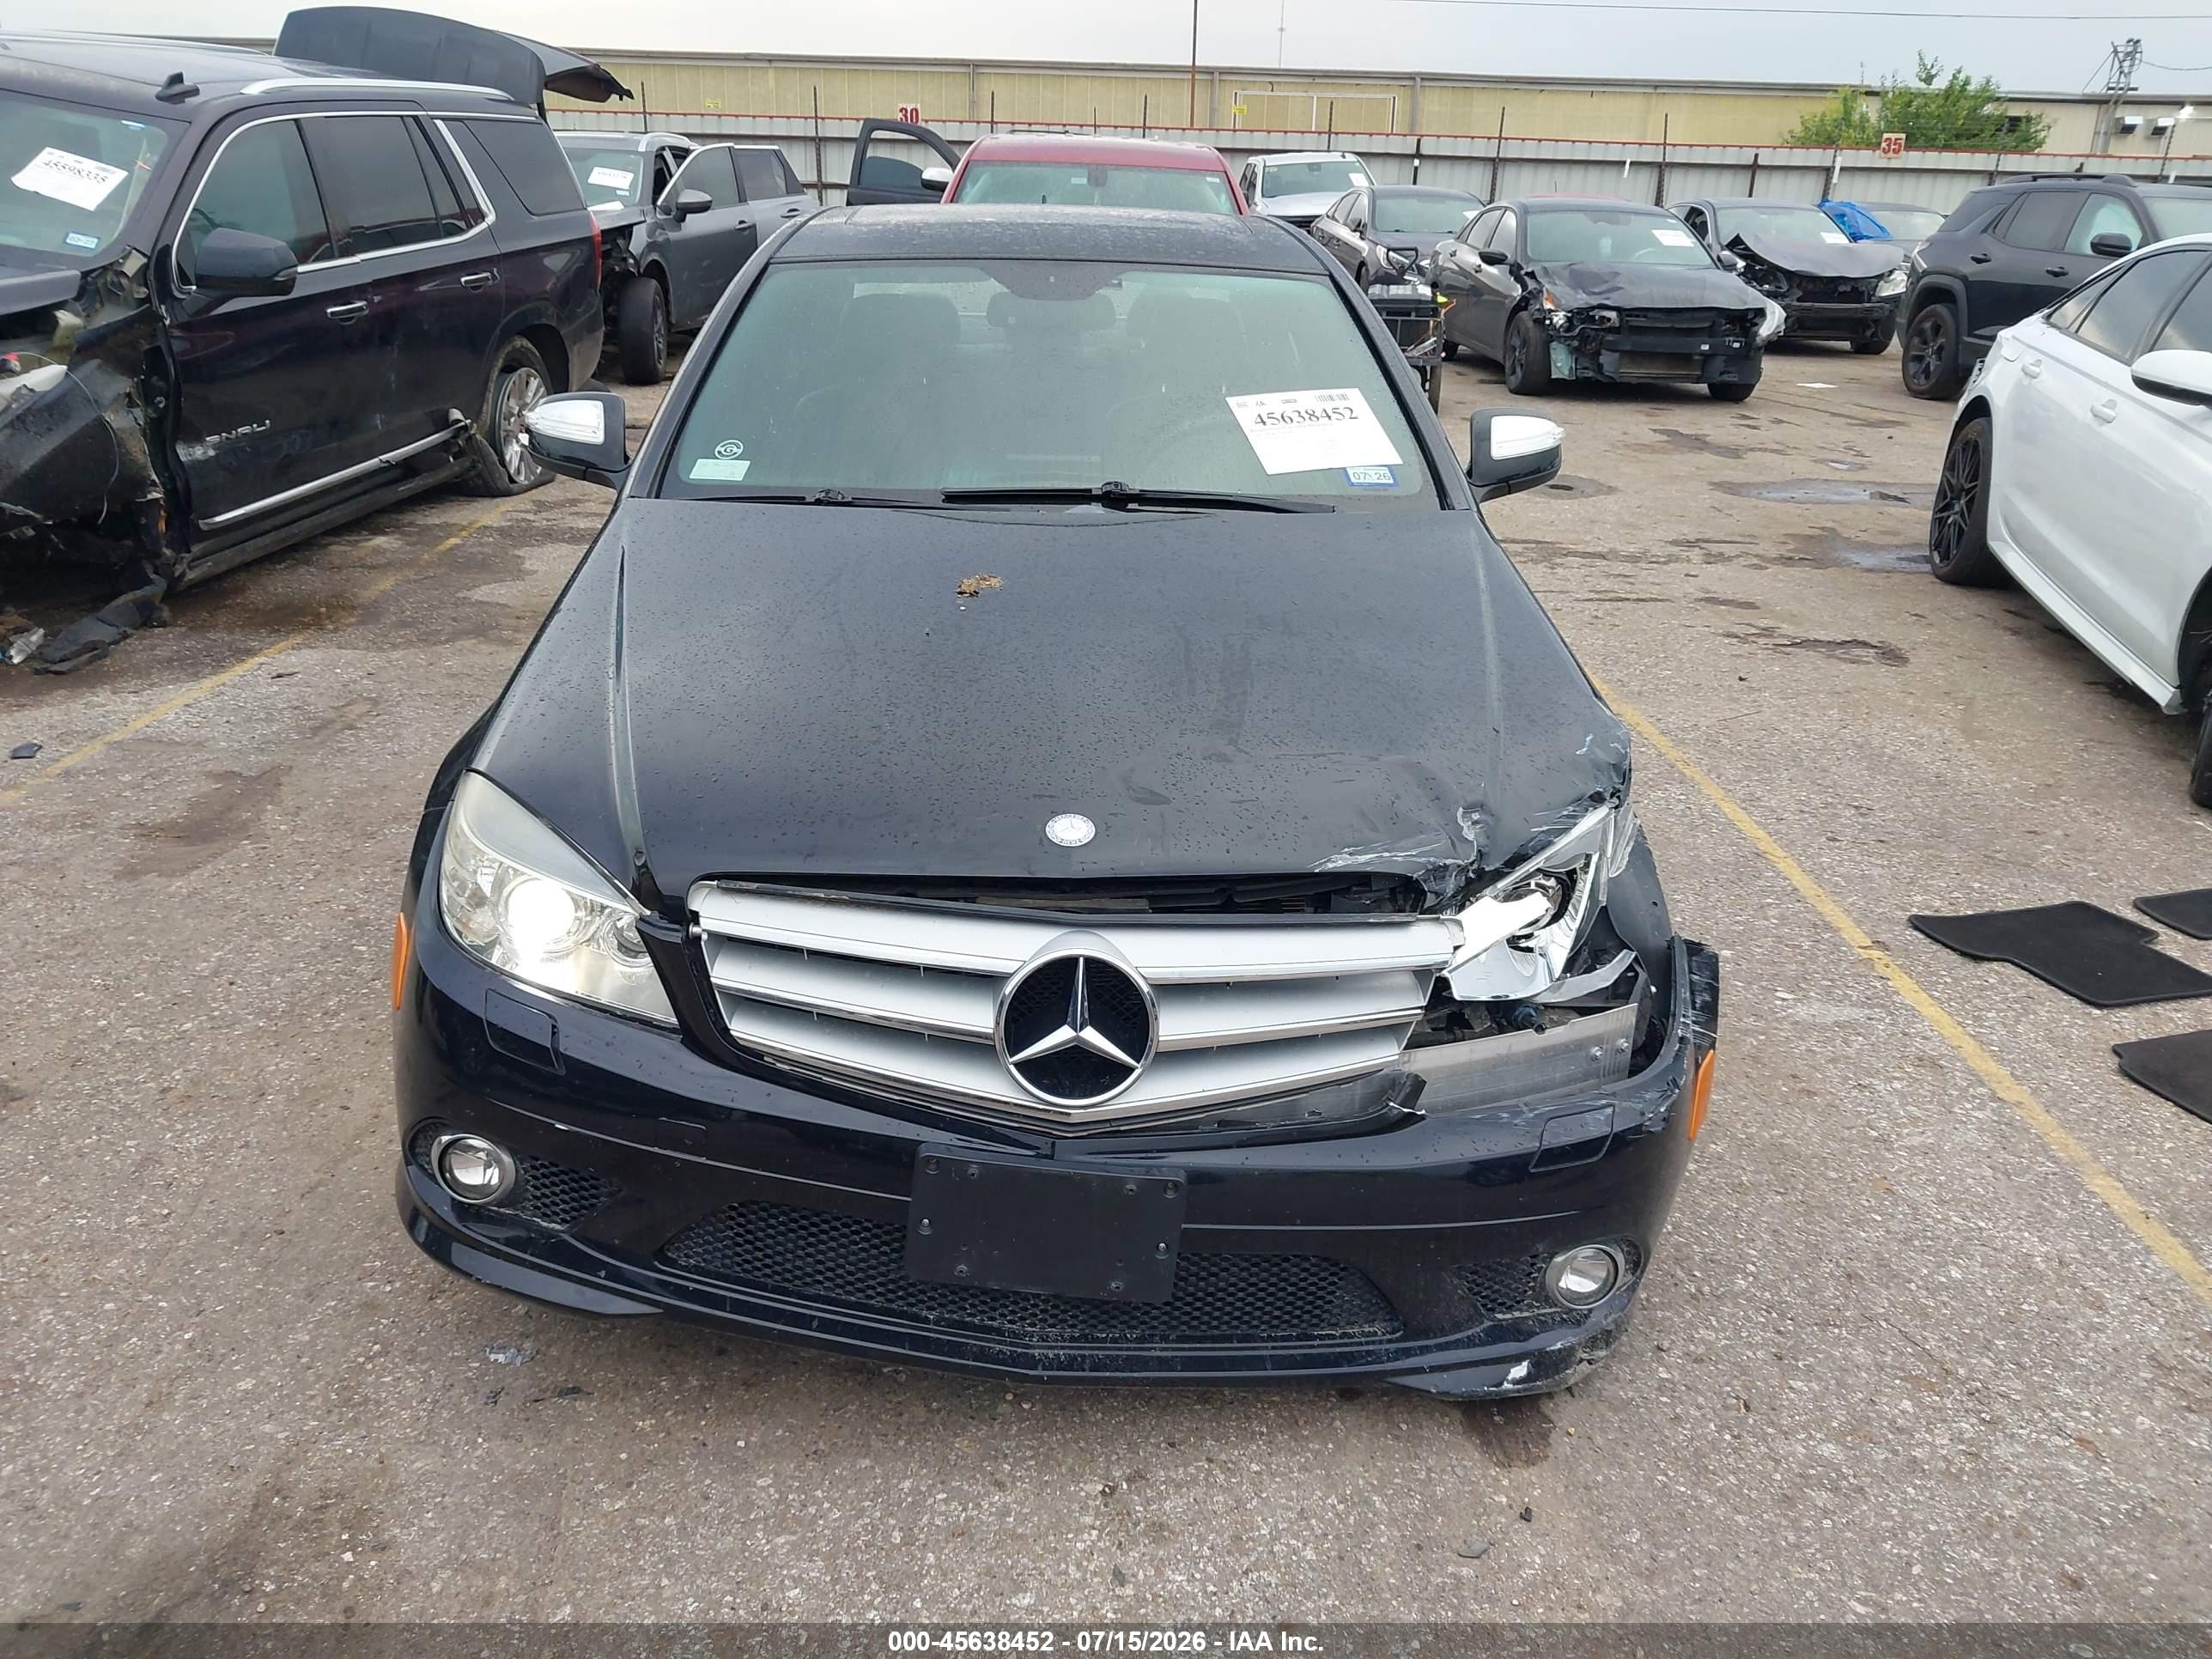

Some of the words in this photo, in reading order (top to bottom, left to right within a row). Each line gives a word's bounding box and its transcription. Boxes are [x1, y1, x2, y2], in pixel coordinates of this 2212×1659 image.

[899, 107, 919, 125] 30
[1882, 137, 1903, 155] 35
[1255, 406, 1358, 426] 45638452
[1352, 471, 1367, 481] 07
[1375, 471, 1391, 481] 26
